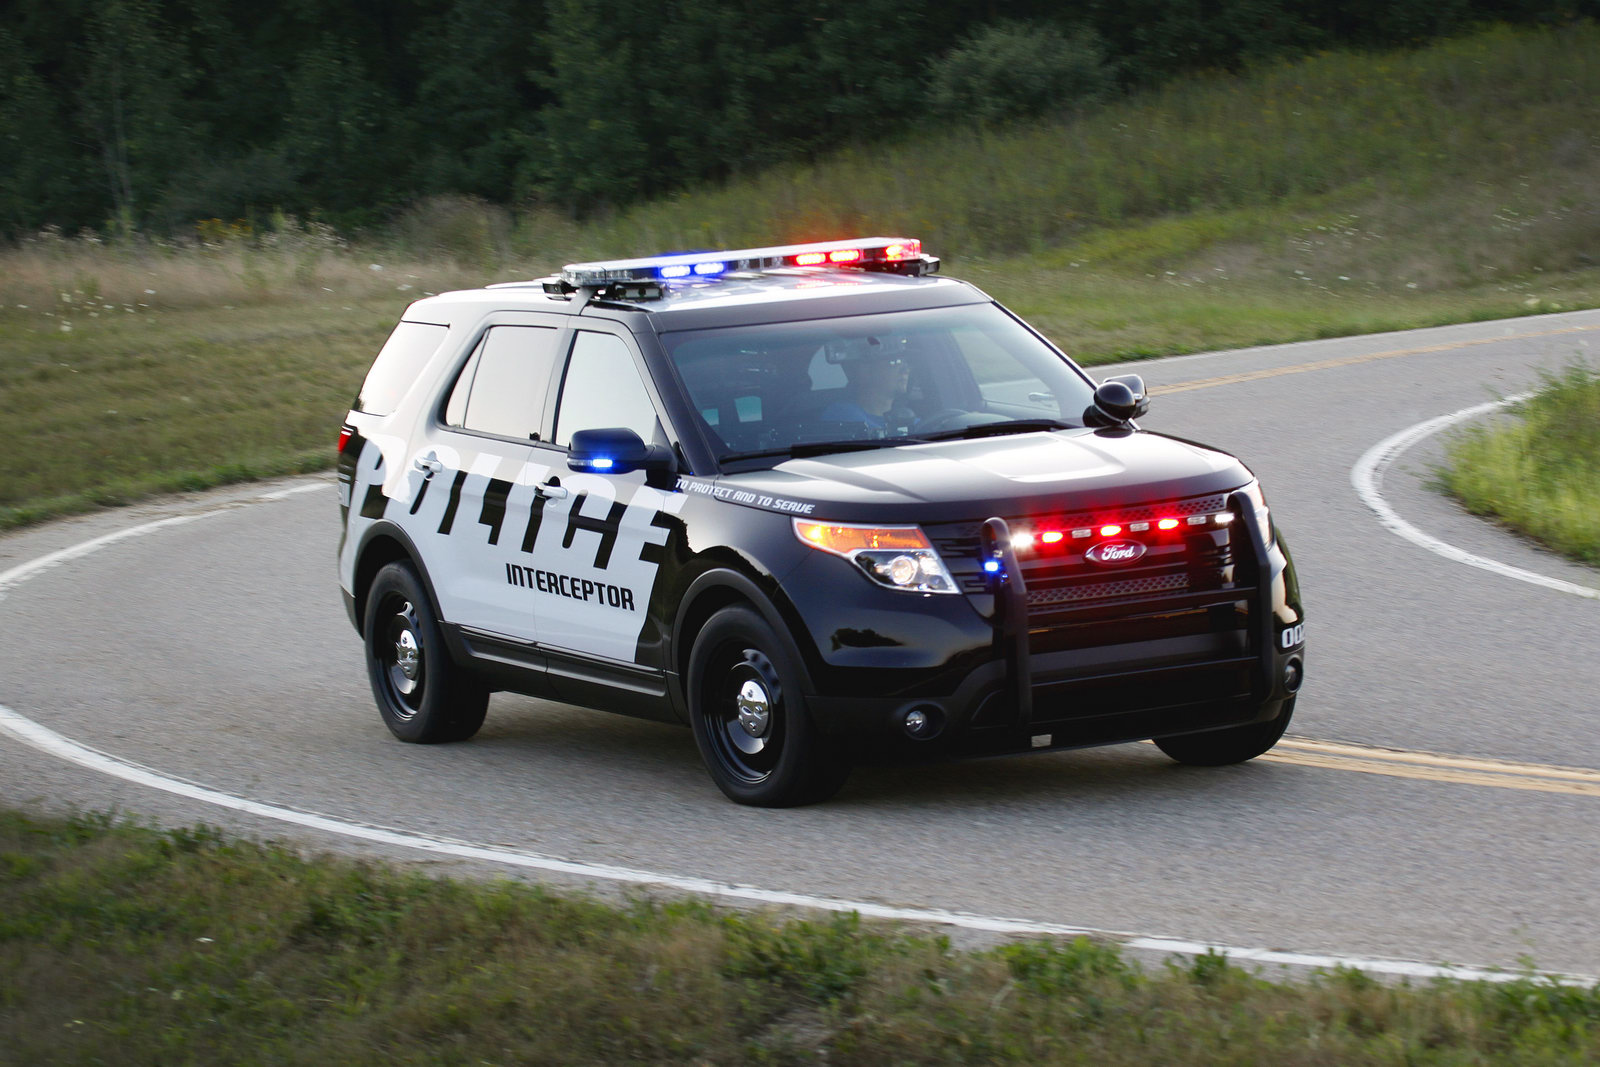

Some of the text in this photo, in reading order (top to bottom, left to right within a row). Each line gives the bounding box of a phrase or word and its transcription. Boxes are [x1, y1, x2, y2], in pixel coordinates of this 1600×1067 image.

[350, 437, 689, 570] POLICE
[675, 478, 815, 514] TO PROTECT AND TO SERVE
[1101, 544, 1135, 560] Ford
[506, 562, 635, 611] INTERCEPTOR
